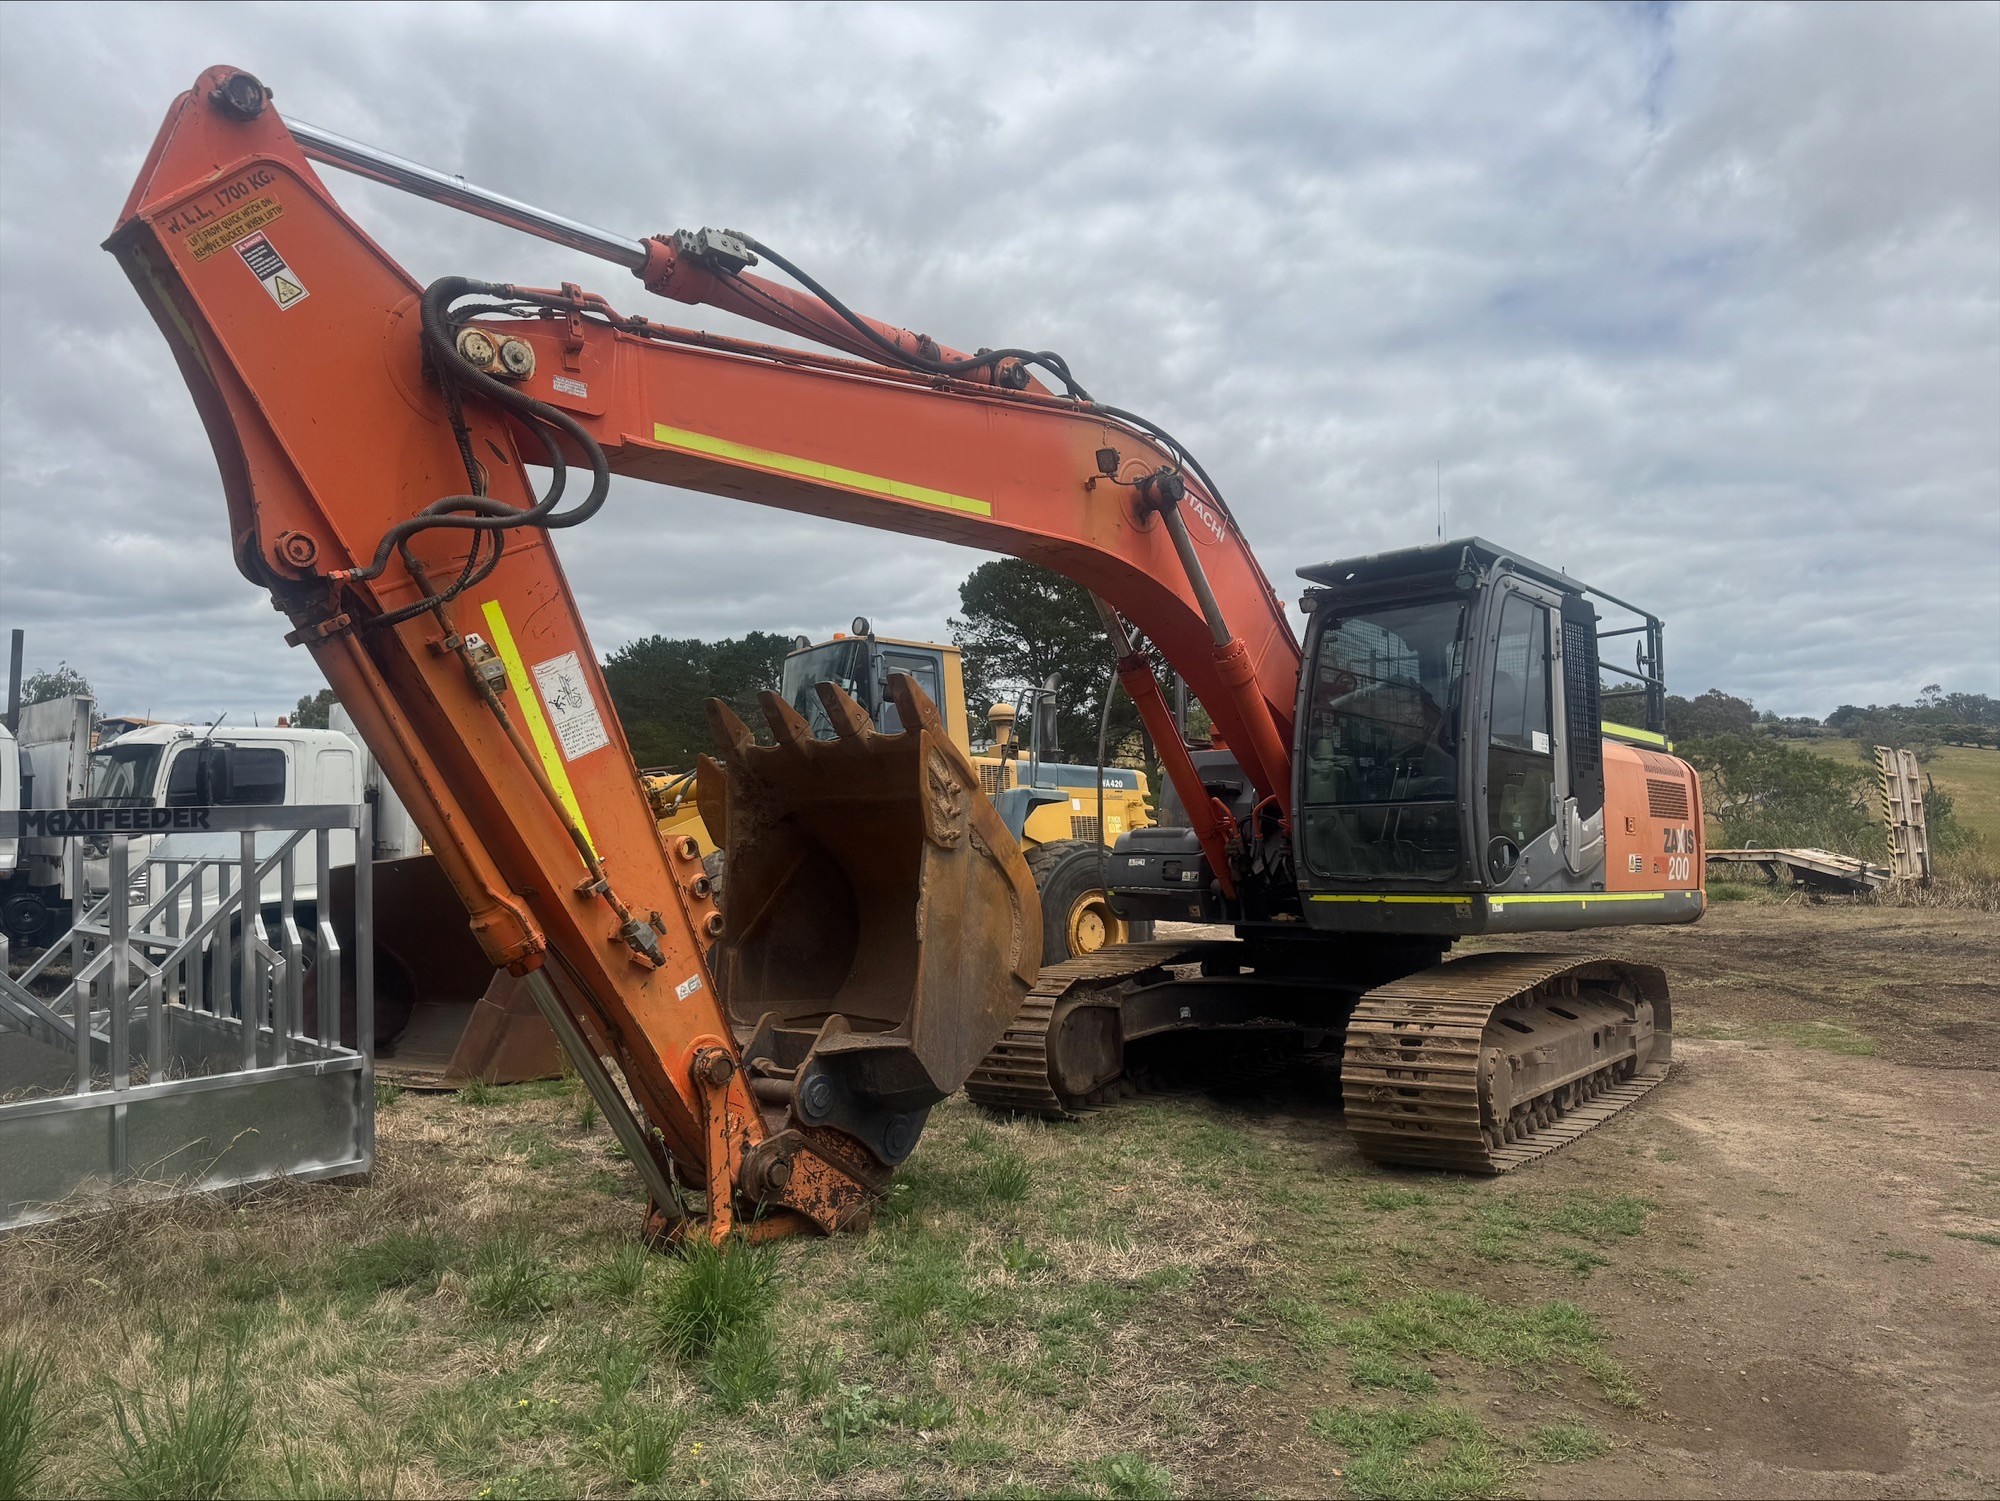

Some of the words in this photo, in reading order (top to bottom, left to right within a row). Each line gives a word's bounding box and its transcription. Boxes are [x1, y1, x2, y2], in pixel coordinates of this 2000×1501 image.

[214, 181, 250, 207] 1700
[193, 238, 221, 259] REMOVE
[220, 225, 247, 245] BUCKET
[245, 215, 265, 230] WHEN
[202, 224, 223, 239] FROM
[221, 212, 243, 230] QUICK
[244, 235, 263, 248] DANGER
[19, 808, 210, 837] MAXIFEEDER
[1663, 823, 1695, 854] ZAXIS
[1668, 856, 1690, 881] 200
